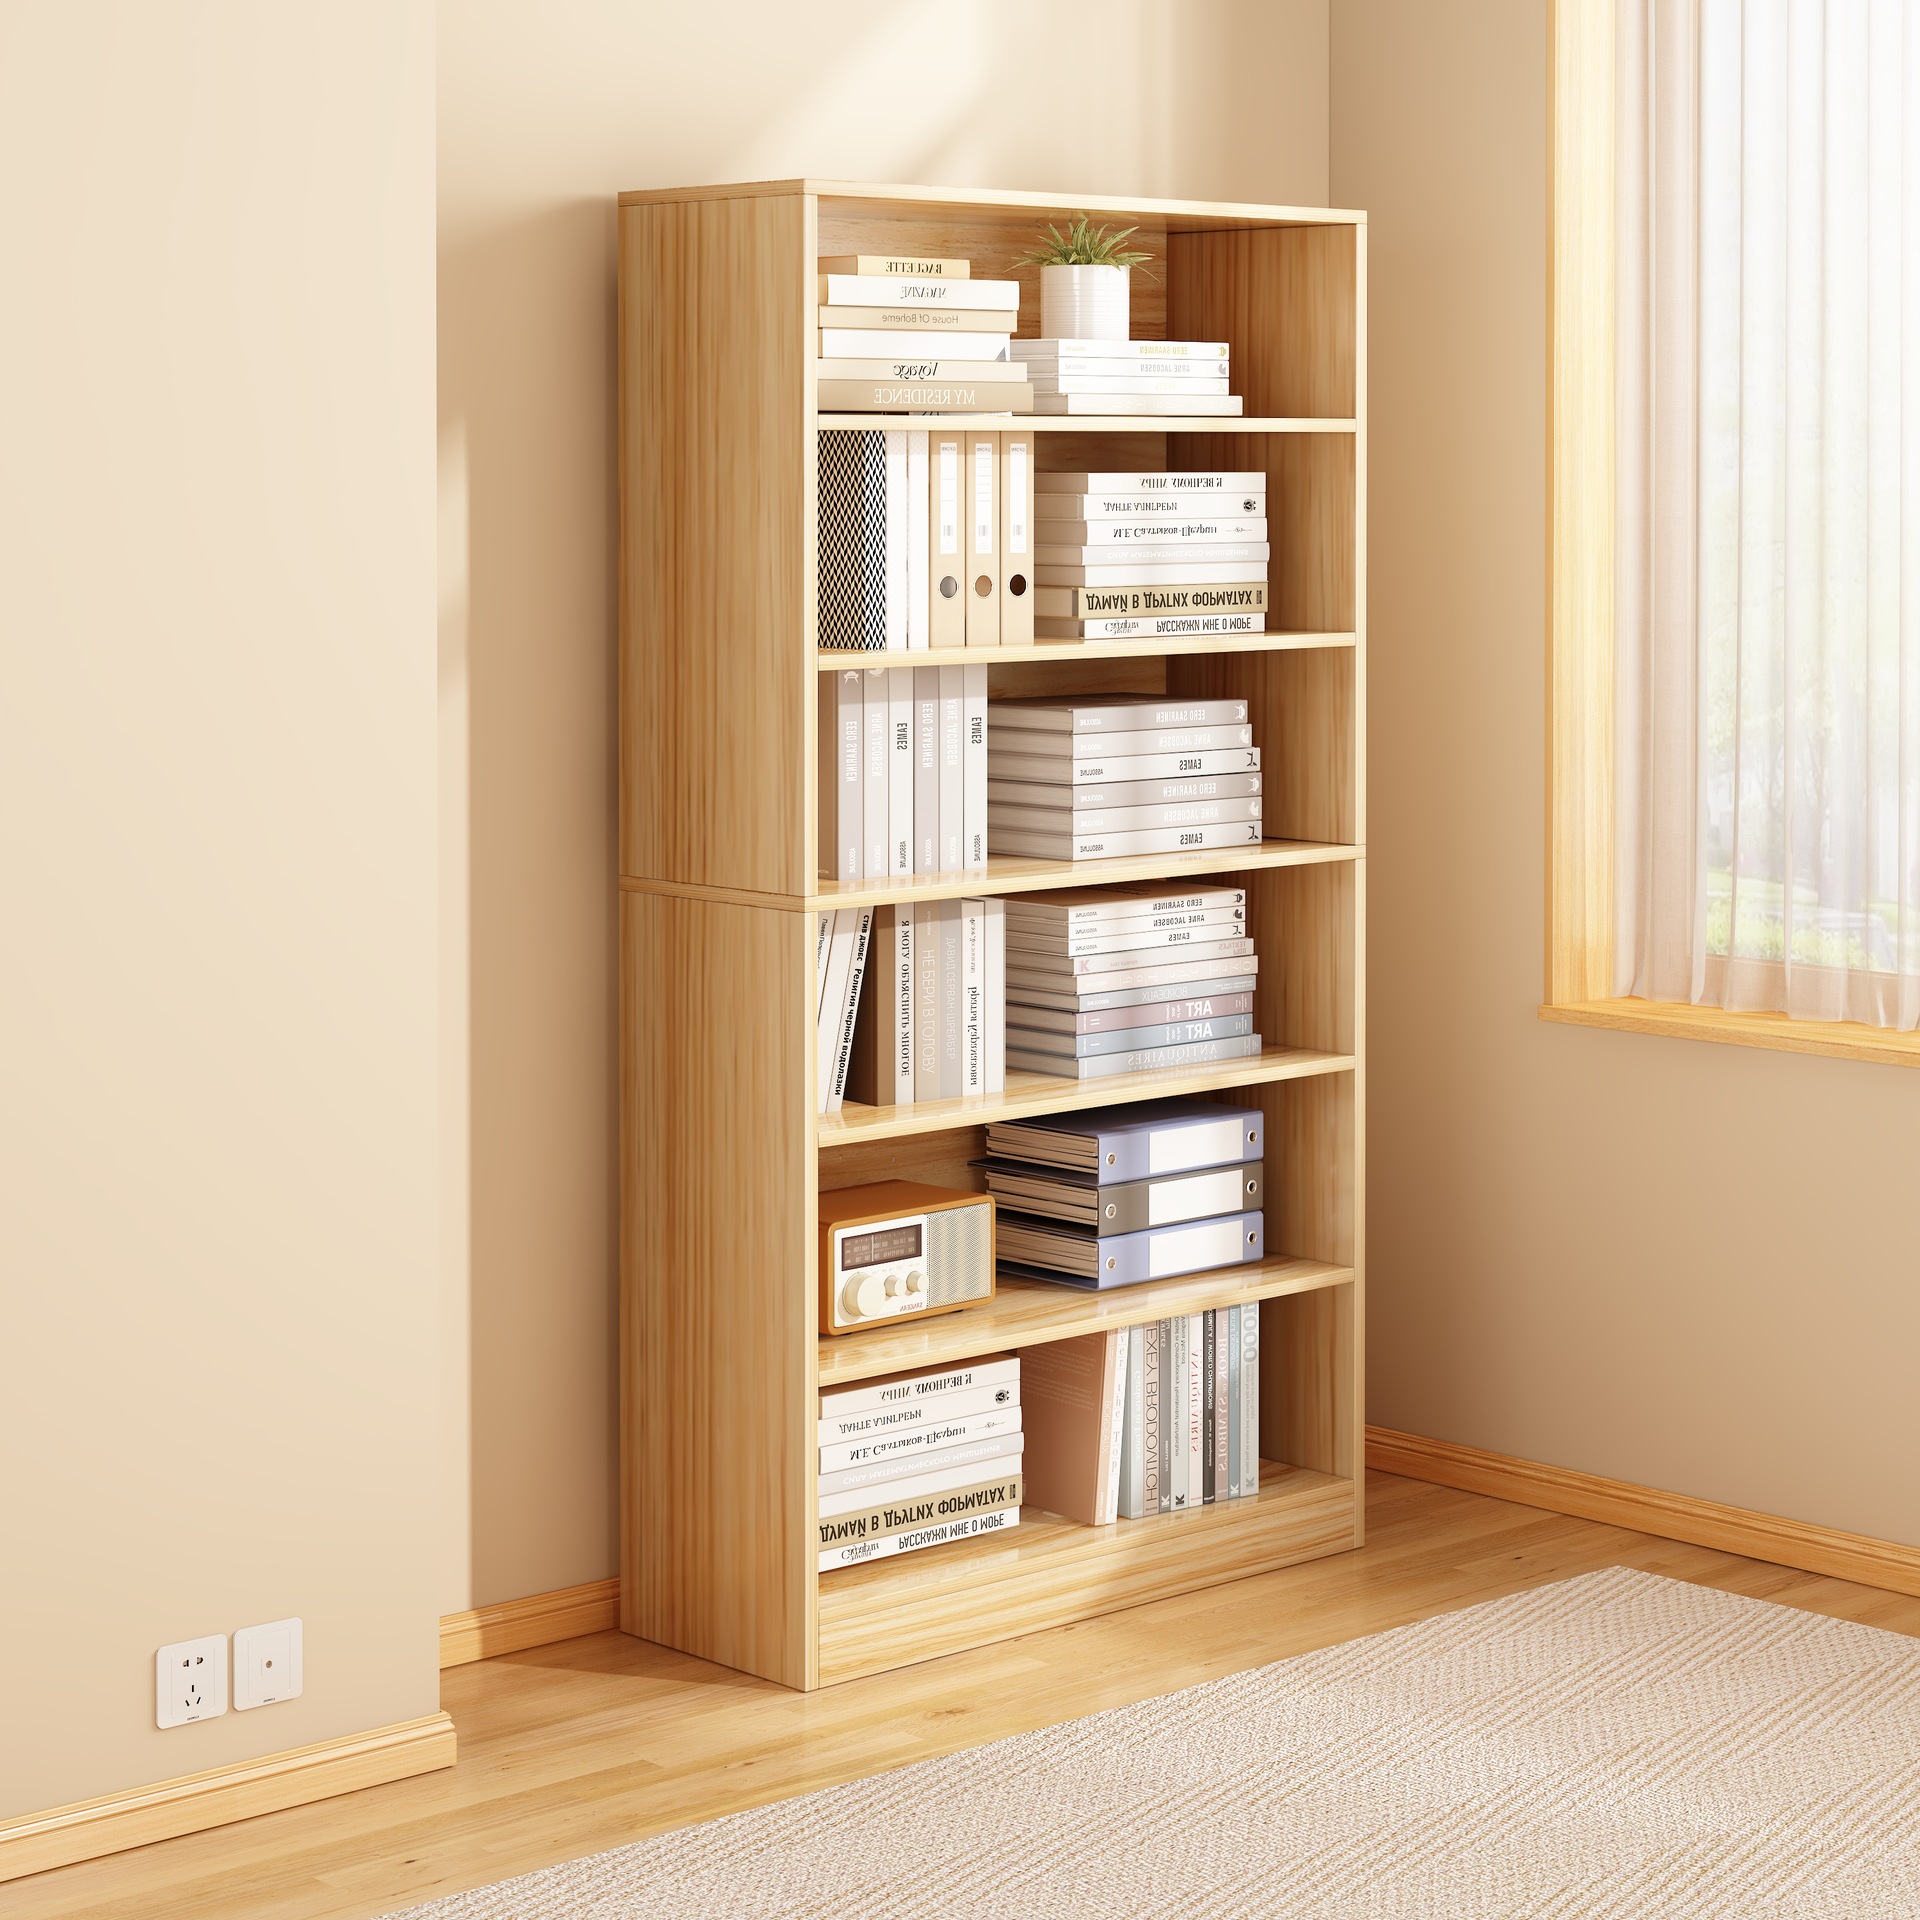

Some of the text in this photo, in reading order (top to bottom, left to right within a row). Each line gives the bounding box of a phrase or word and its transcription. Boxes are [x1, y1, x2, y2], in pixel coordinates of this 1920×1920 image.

[857, 914, 870, 961] стив джобс
[901, 930, 910, 959] МОГУ
[922, 949, 935, 965] НЕ
[946, 938, 956, 970] ДАВИД
[901, 964, 910, 1028] ОБЪЯСНИТЬ
[922, 971, 935, 1006] БЕРИ
[835, 968, 862, 1096] Религия черной водолазки
[922, 1009, 934, 1017] В
[901, 1032, 909, 1076] МНОГОЕ
[922, 1021, 935, 1073] ГОЛОВУ
